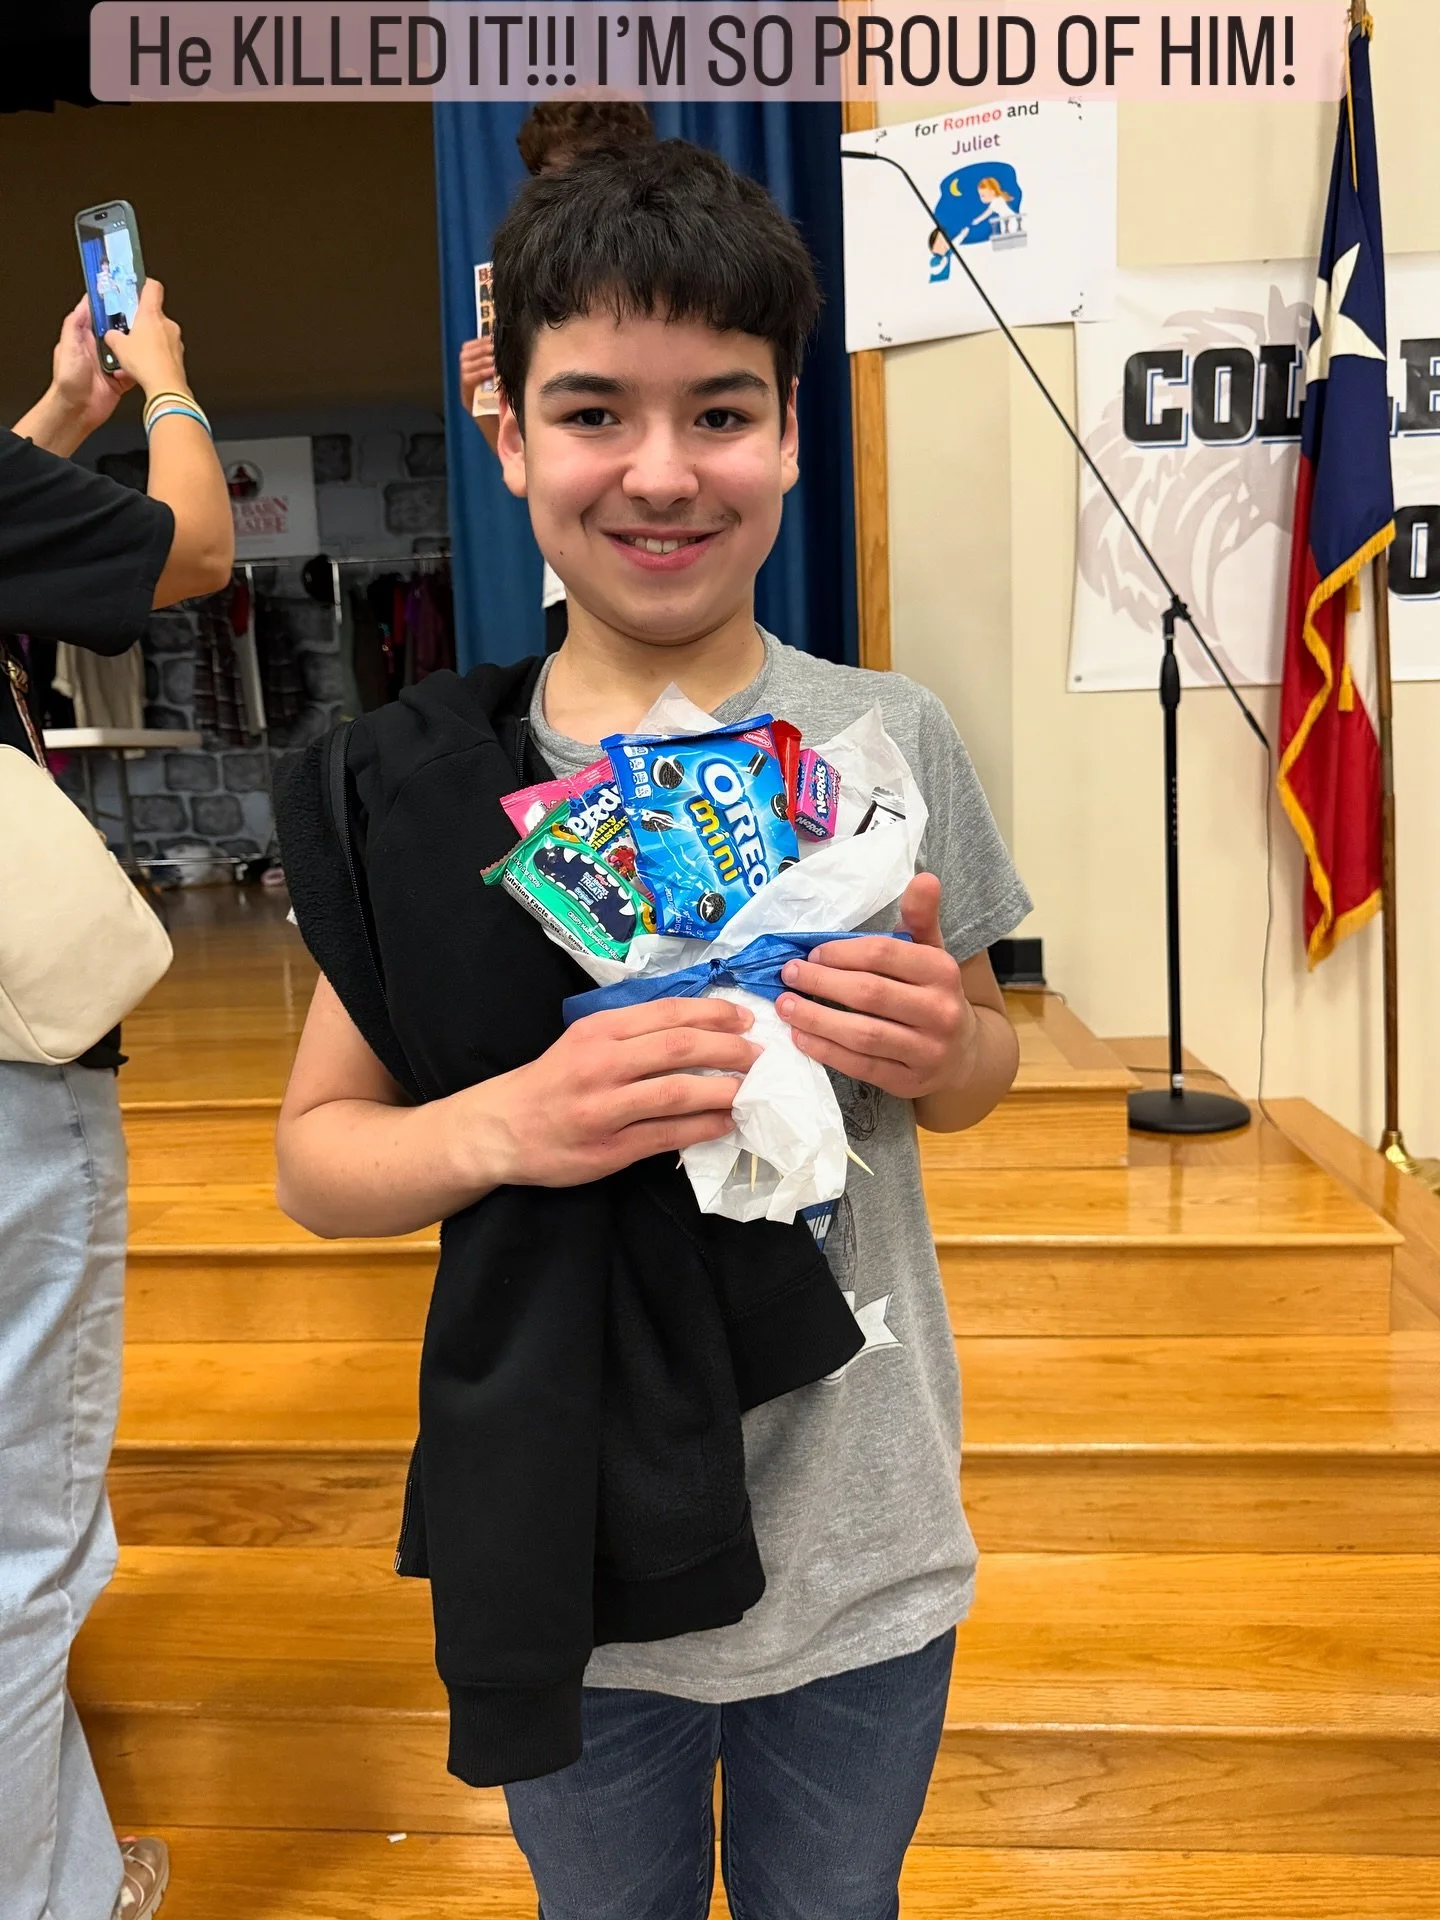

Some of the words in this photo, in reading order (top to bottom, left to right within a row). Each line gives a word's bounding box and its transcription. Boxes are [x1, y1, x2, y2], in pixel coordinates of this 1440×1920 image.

[914, 123, 938, 138] for
[943, 109, 1002, 132] Romeo
[1007, 101, 1039, 118] and
[951, 133, 1001, 156] Juliet
[1123, 339, 1440, 448] COLE
[689, 799, 743, 882] mini
[703, 762, 768, 894] OREO
[504, 870, 530, 900] Nutrition
[530, 899, 549, 918] Facts
[580, 876, 604, 900] TREATS
